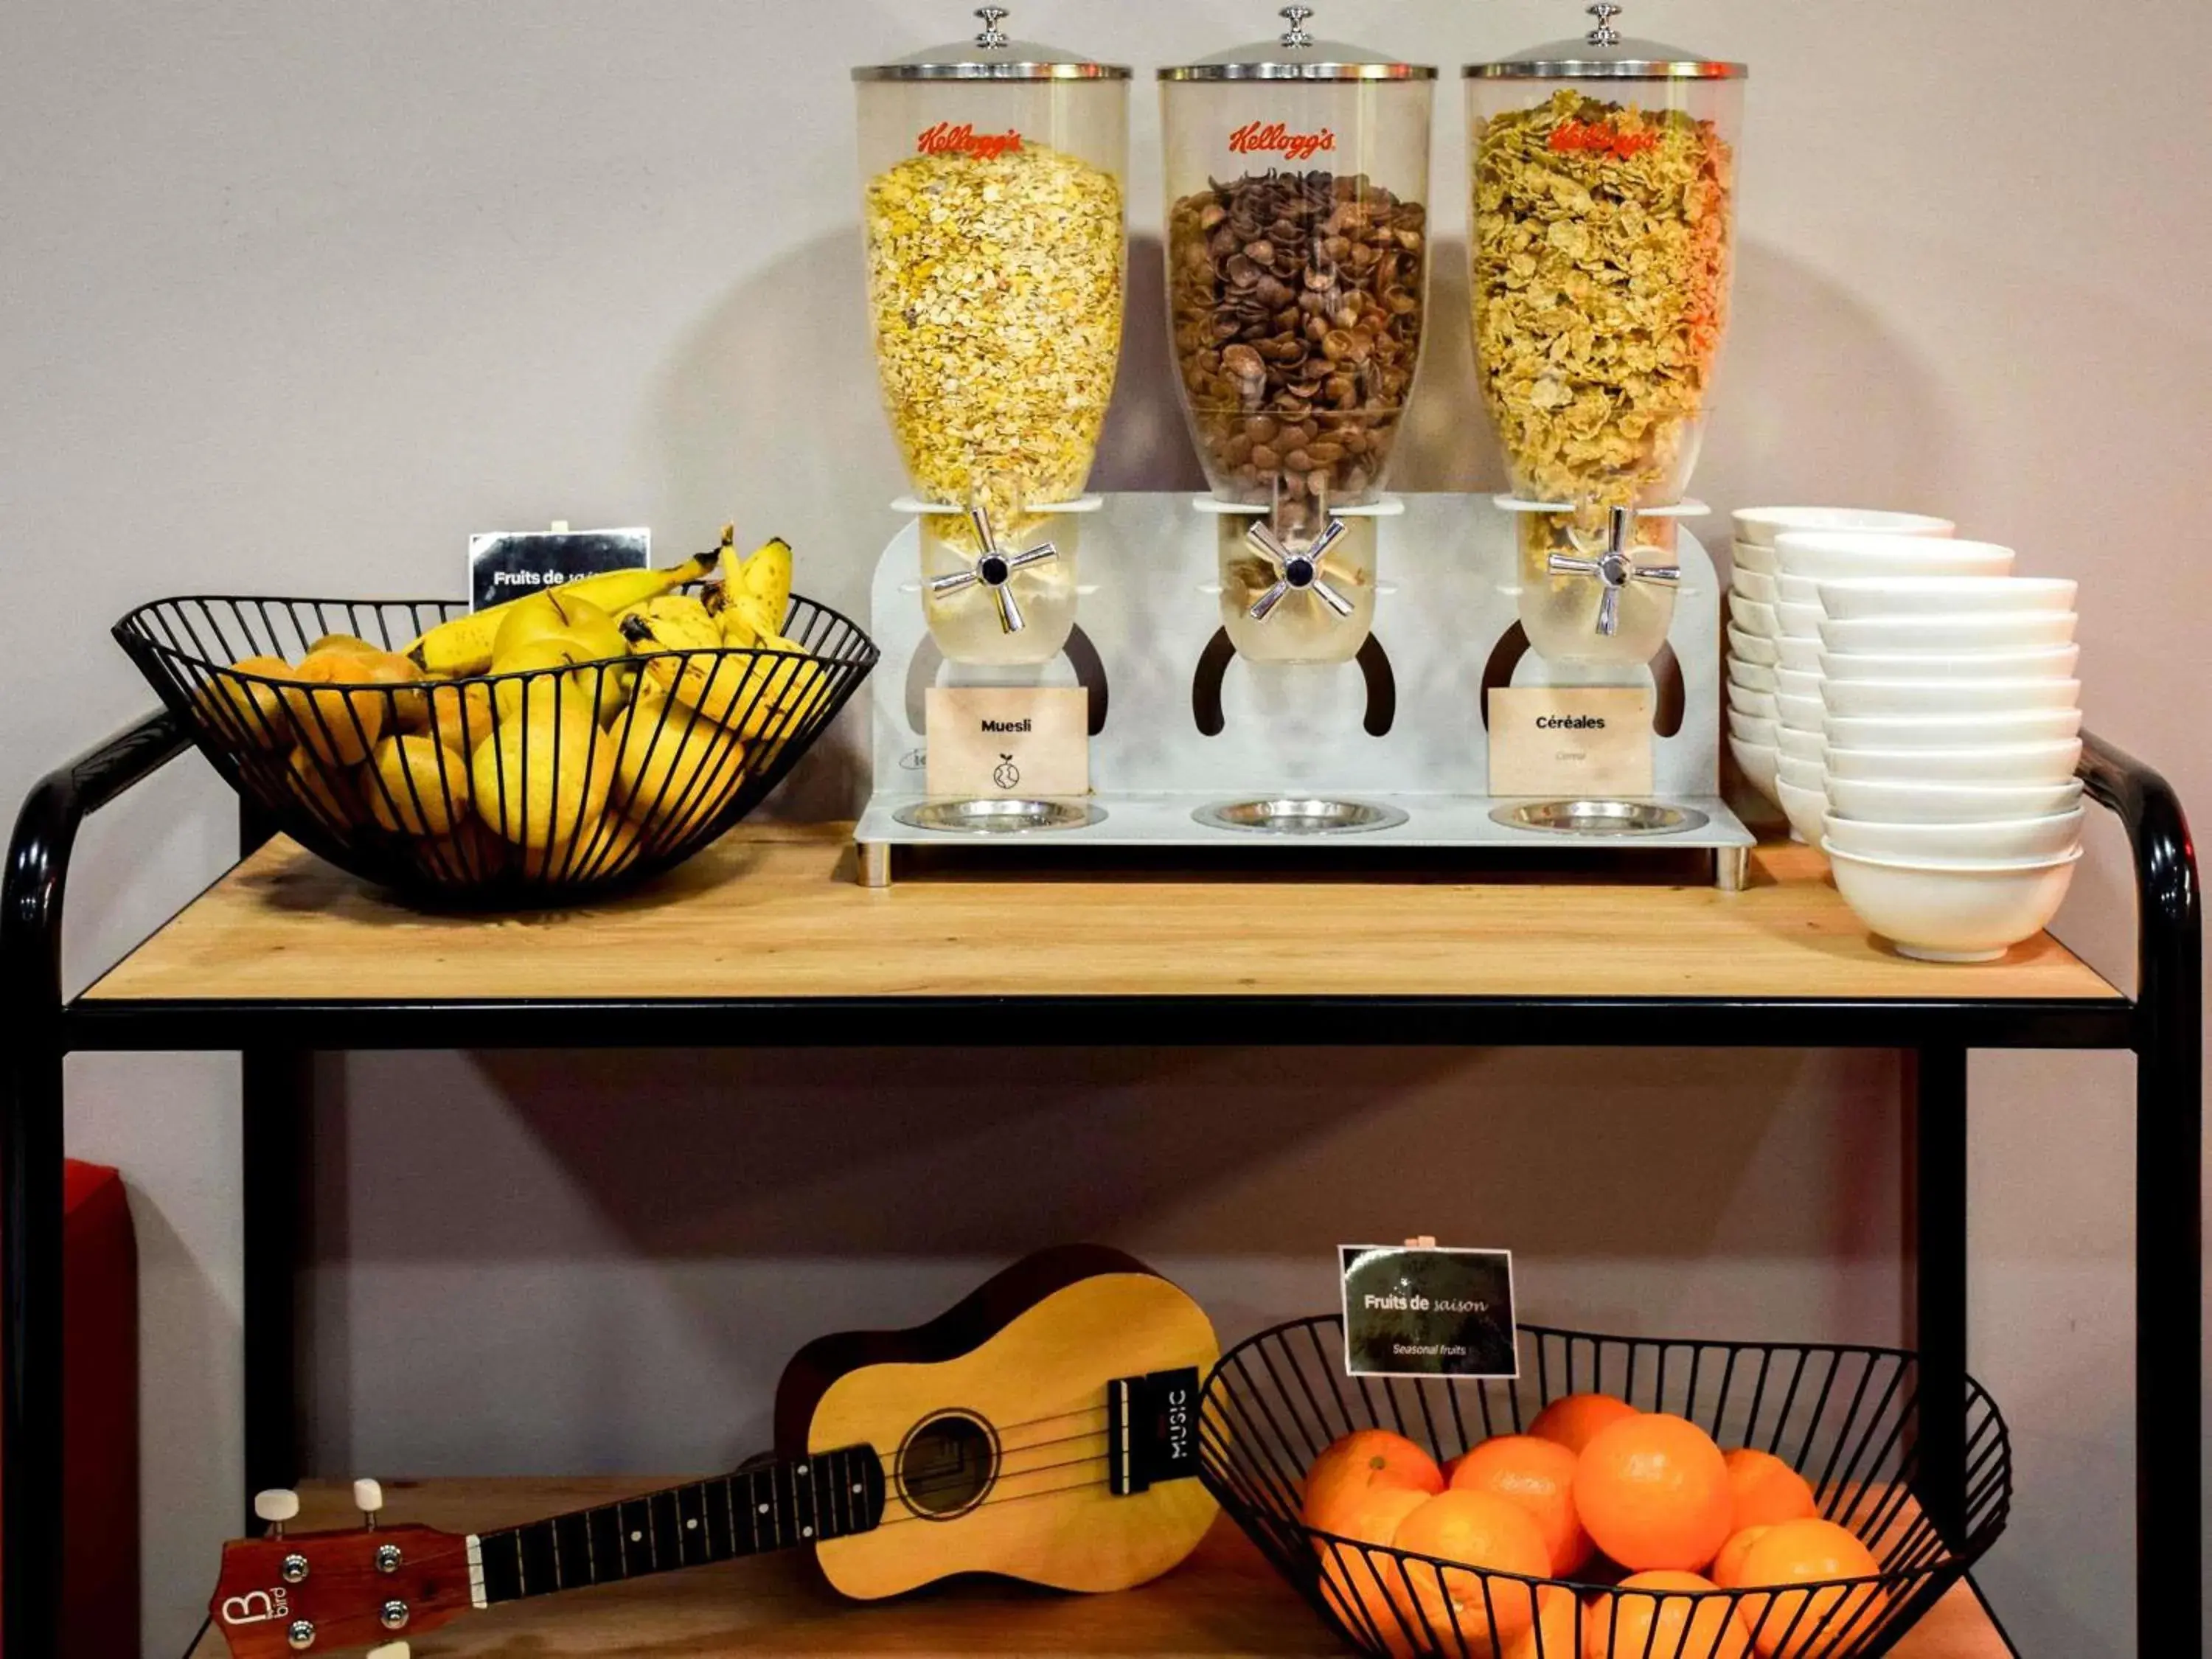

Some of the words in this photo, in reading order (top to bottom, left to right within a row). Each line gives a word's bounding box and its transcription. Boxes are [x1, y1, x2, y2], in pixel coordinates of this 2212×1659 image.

[917, 122, 1023, 160] Kellogg's
[1229, 121, 1335, 159] Kellogg's
[494, 570, 540, 585] Fruits
[543, 569, 564, 584] de
[981, 719, 1032, 732] Muesli
[1536, 714, 1606, 729] Céréales
[1365, 1293, 1408, 1311] Fruits
[1410, 1295, 1430, 1311] de
[1434, 1298, 1489, 1313] saison
[1393, 1343, 1439, 1356] Seasonal
[1440, 1344, 1467, 1357] fruits
[1169, 1390, 1187, 1459] MUSIC
[269, 1587, 289, 1619] bird
